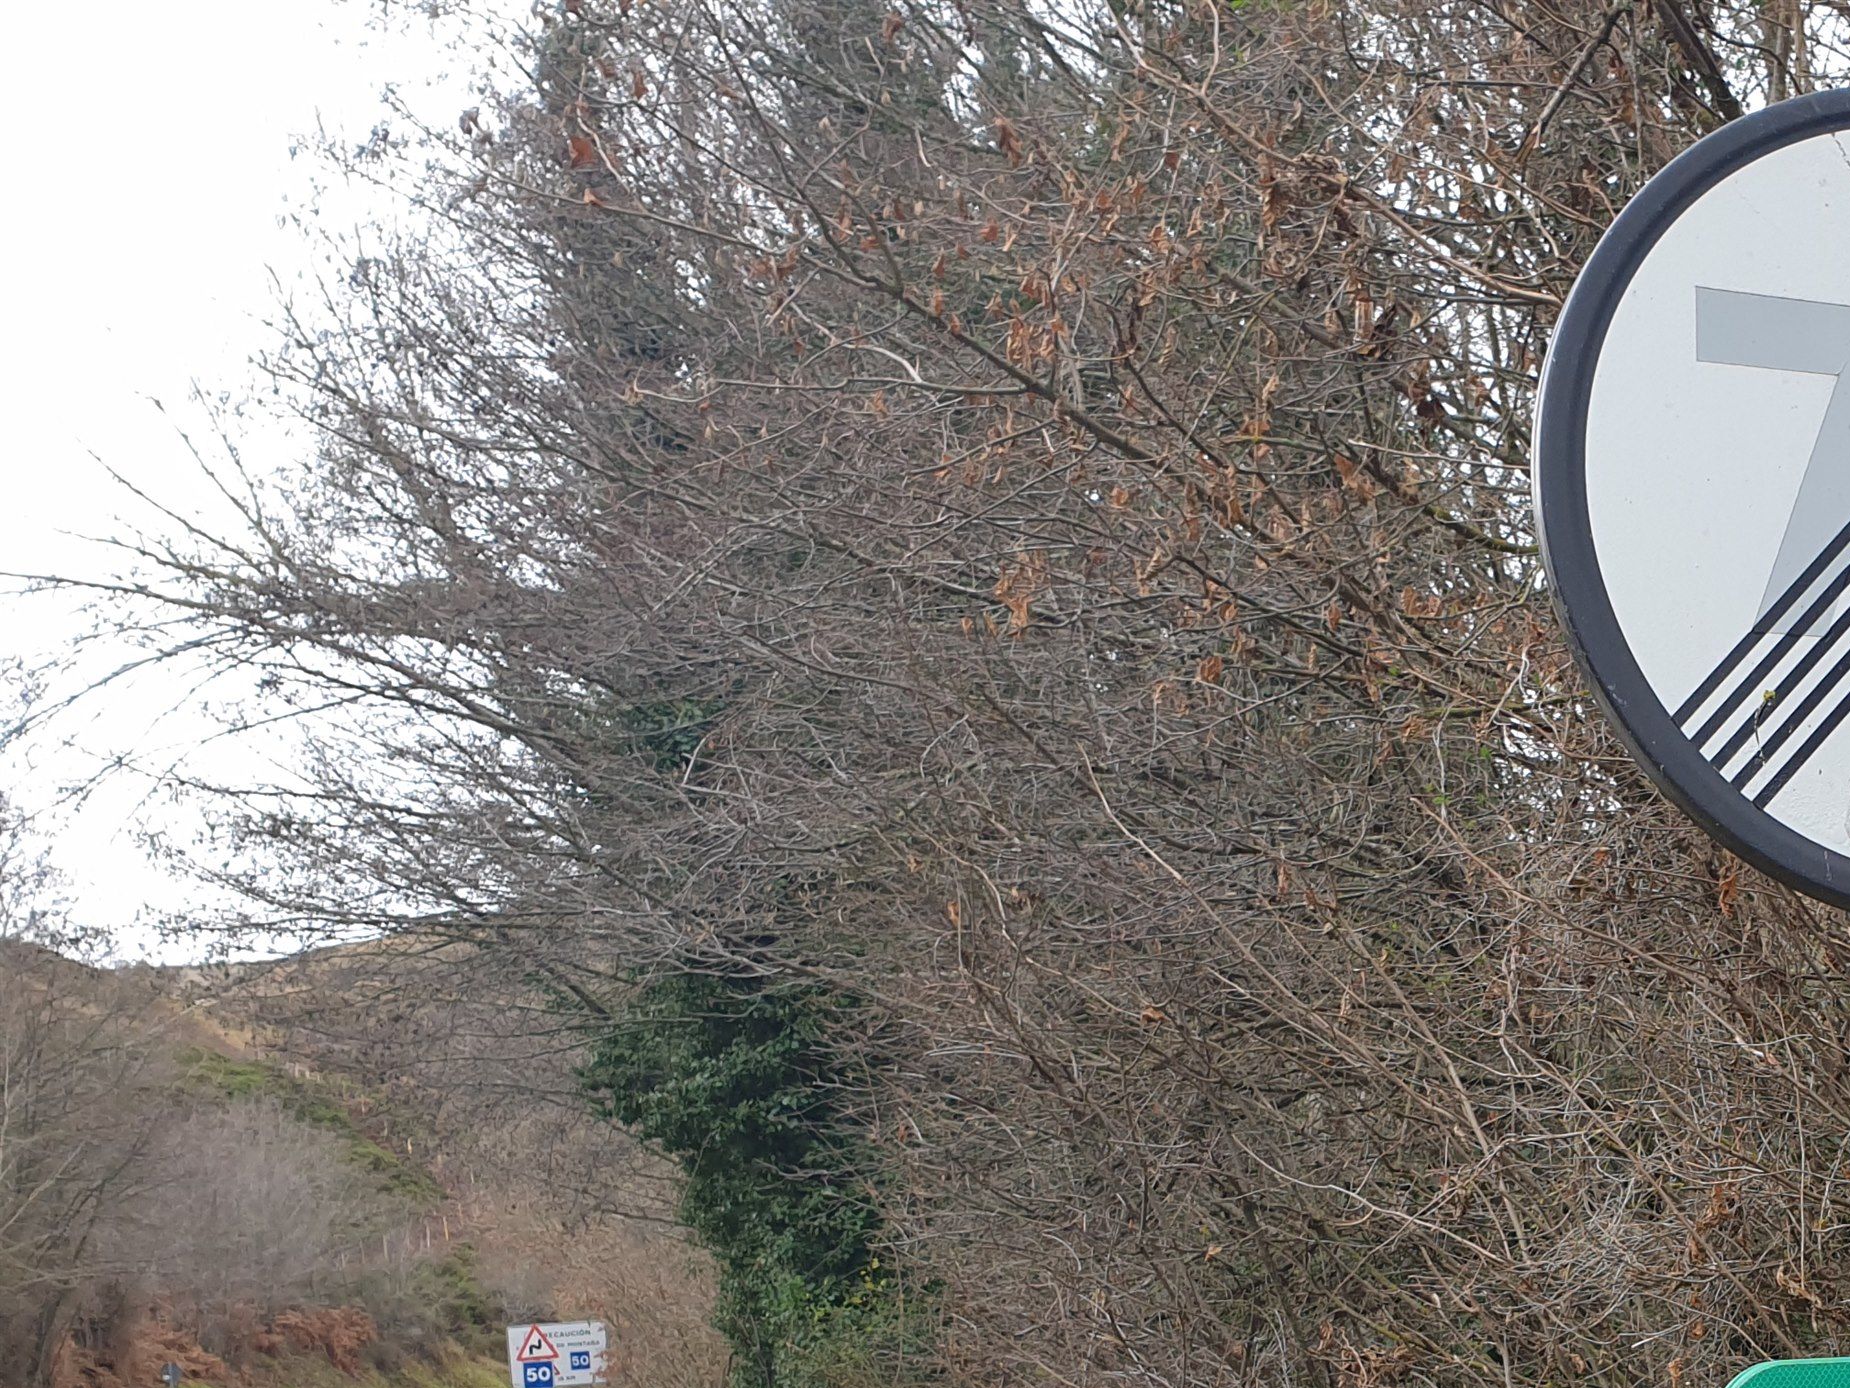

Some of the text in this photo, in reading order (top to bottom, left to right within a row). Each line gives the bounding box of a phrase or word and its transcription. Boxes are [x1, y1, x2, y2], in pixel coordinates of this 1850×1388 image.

[545, 1329, 591, 1338] ECAUCIÓN
[571, 1355, 589, 1366] 50
[526, 1366, 551, 1382] 50
